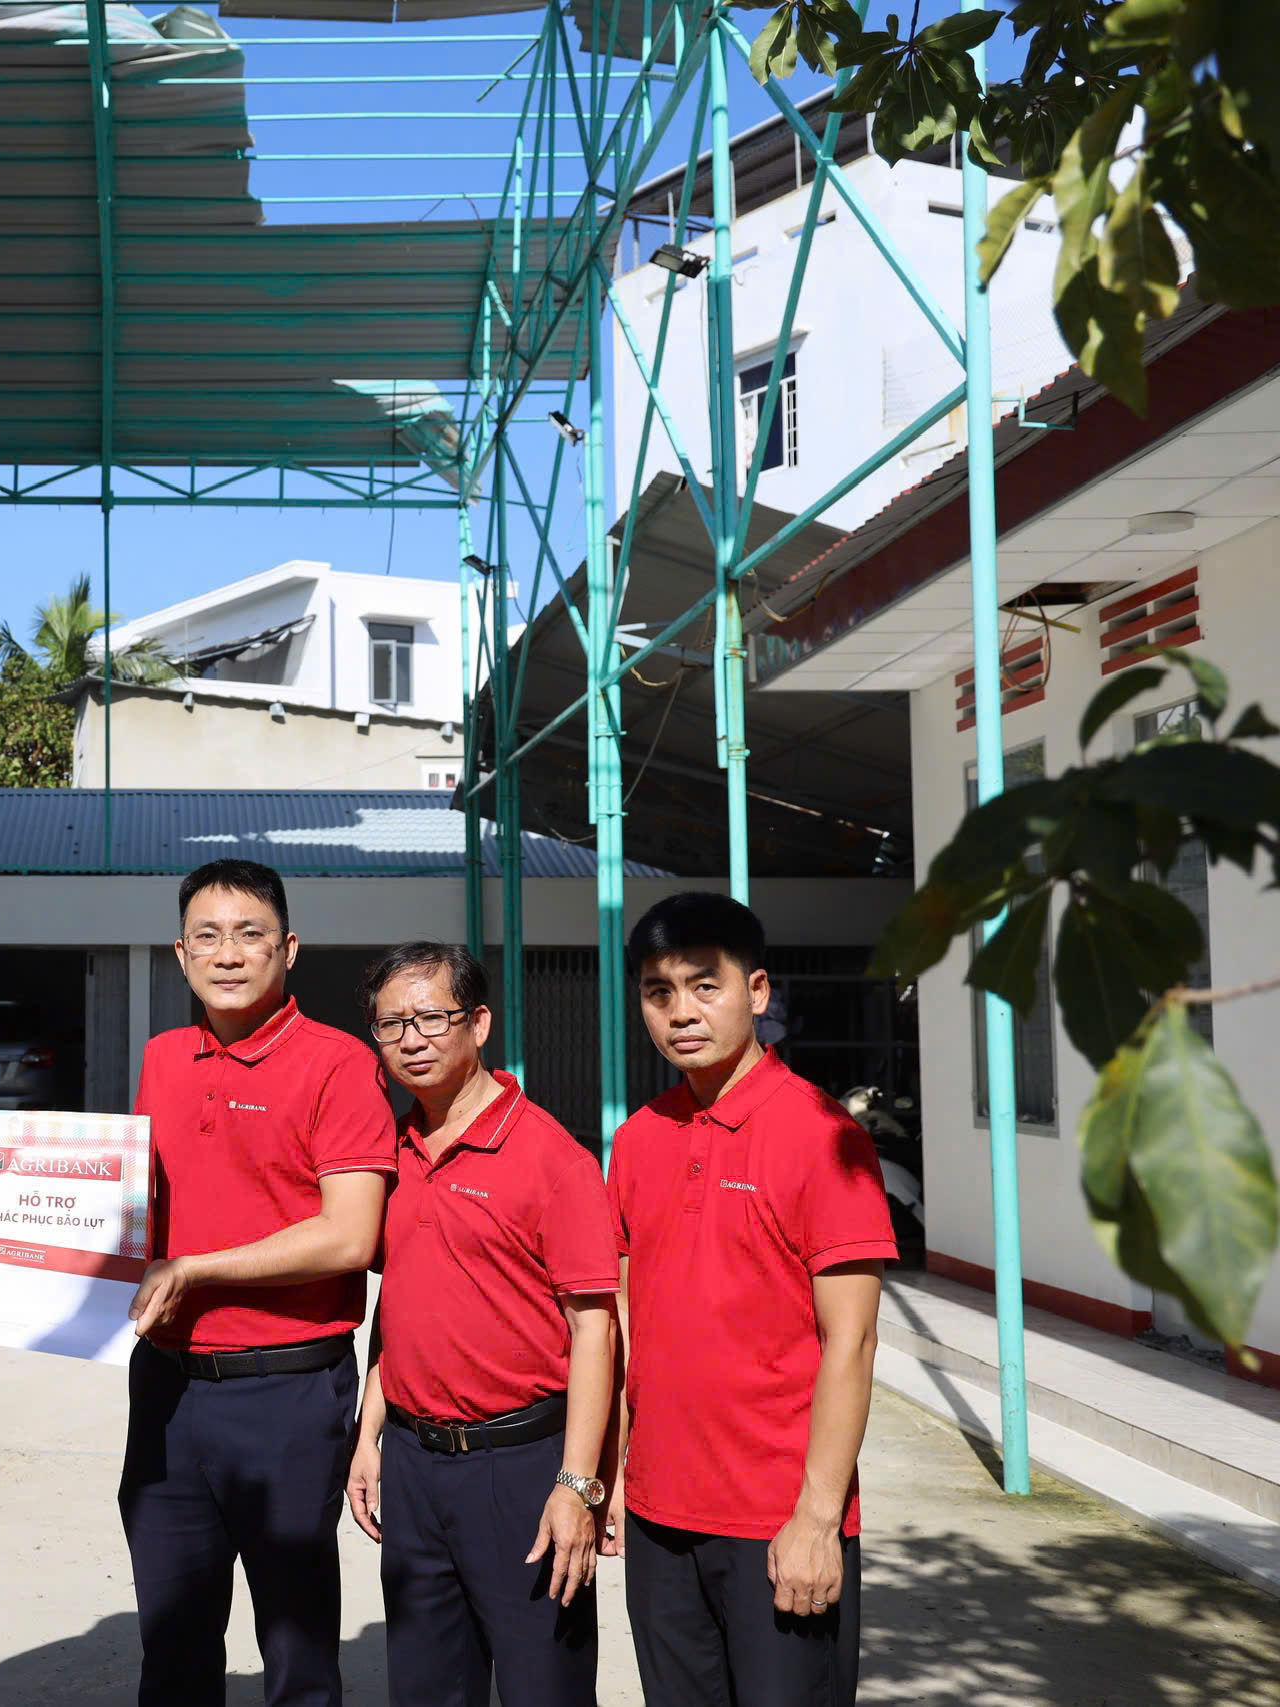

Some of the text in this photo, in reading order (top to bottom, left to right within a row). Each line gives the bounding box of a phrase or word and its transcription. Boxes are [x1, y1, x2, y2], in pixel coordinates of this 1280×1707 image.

[236, 1103, 267, 1112] AGRIBANK
[6, 1157, 113, 1177] AGRIBANK
[18, 1190, 77, 1212] HỖ TRỢ
[22, 1213, 53, 1227] PHỤC
[84, 1217, 105, 1230] LỤT
[6, 1249, 45, 1261] AGRIBANK
